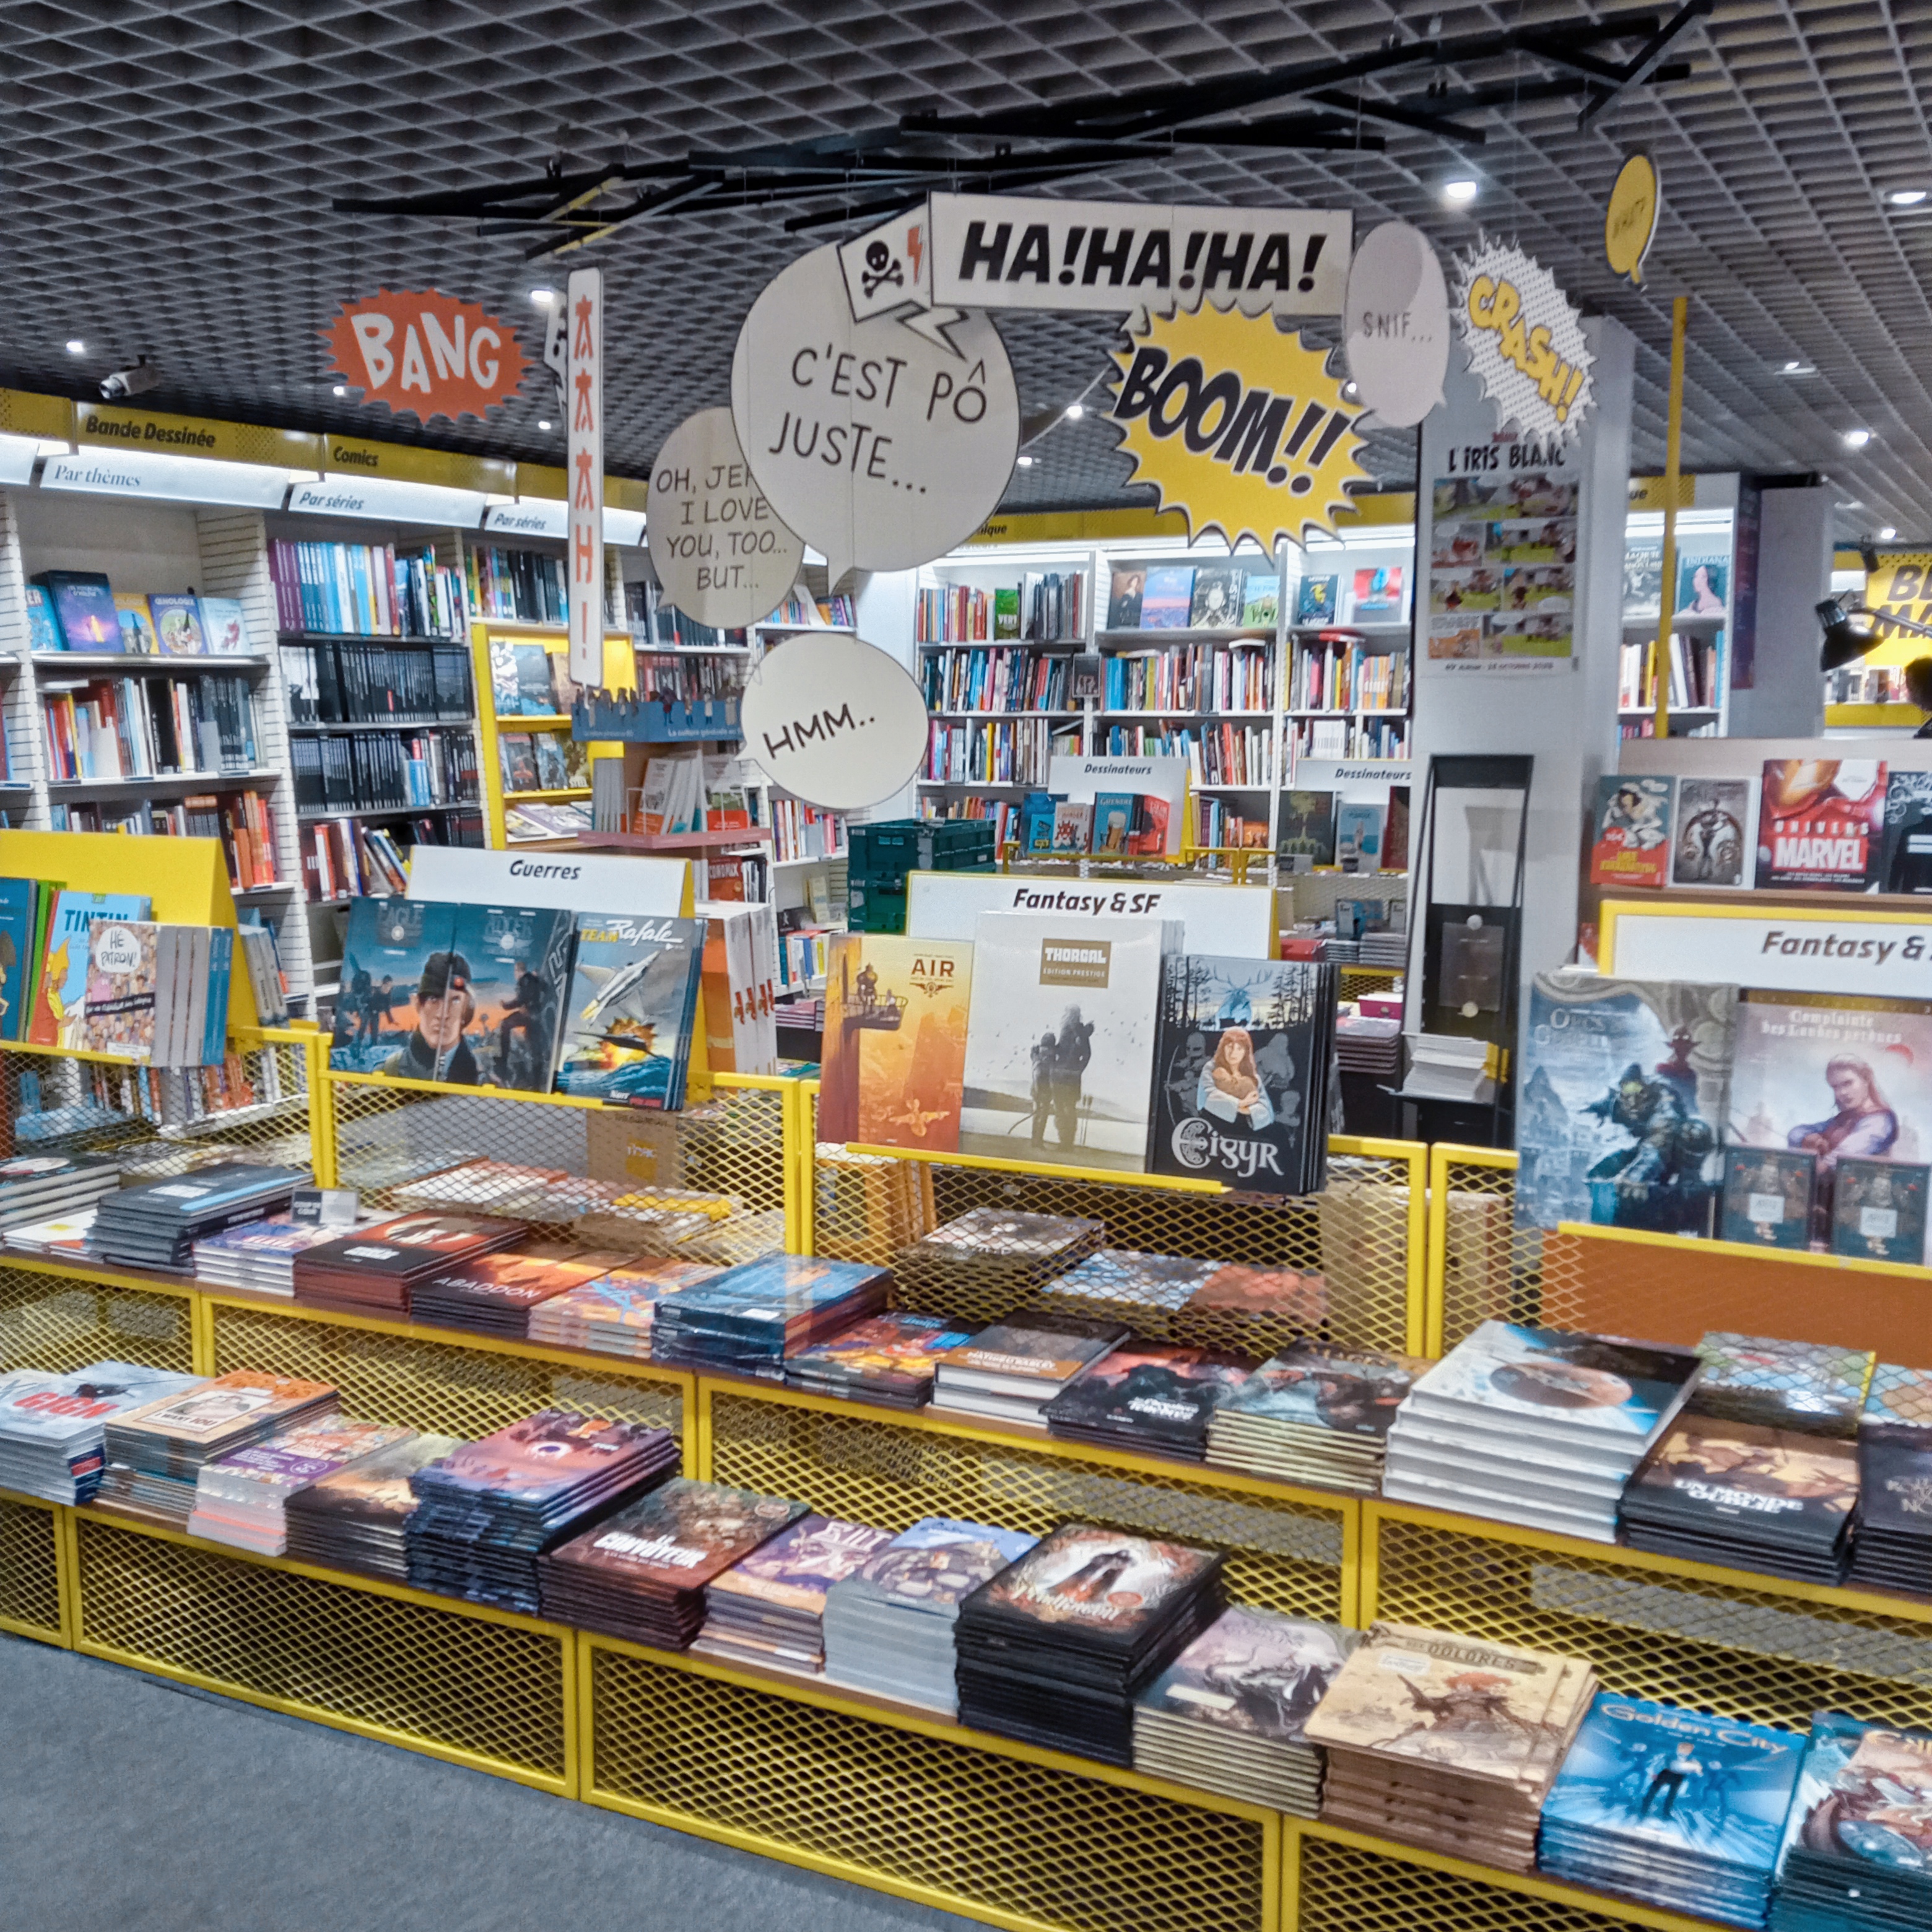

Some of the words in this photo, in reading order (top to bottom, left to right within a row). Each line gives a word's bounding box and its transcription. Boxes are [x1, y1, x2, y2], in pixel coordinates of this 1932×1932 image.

[1362, 313, 1433, 342] SNIF...
[351, 311, 501, 394] BANG
[791, 342, 908, 408] C'EST
[925, 358, 988, 424] PÔ
[85, 414, 141, 440] Bande
[144, 421, 215, 448] Dessinée
[1113, 347, 1354, 495] BOOM!!
[333, 445, 379, 468] Comics
[768, 412, 927, 494] JUSTE...
[53, 464, 82, 483] Par
[84, 466, 142, 488] thèmes
[656, 468, 697, 495] OH,
[299, 492, 323, 508] Par
[325, 494, 365, 511] séries
[682, 500, 695, 525] I
[704, 497, 769, 524] LOVE
[495, 512, 514, 527] Par
[516, 515, 546, 531] séries
[666, 533, 720, 560] YOU,
[697, 565, 759, 592] BUT...
[762, 702, 876, 759] HMM..
[1084, 762, 1152, 776] Dessinateurs
[1335, 767, 1412, 780] Dessinateurs
[1775, 837, 1865, 870] MARVEL
[509, 859, 581, 881] Guerres
[1012, 887, 1107, 916] Fantasy
[1110, 892, 1126, 912] &
[1129, 892, 1161, 913] SF
[580, 929, 619, 942] TEAM
[606, 920, 684, 946] Rafale
[1045, 947, 1107, 964] THORGAL
[1761, 931, 1897, 965] Fantasy
[1901, 936, 1925, 960] &
[911, 959, 955, 978] AIR
[434, 1276, 541, 1300] ABADDON
[13, 1392, 119, 1419] GIGN
[1601, 1704, 1711, 1737] Golden
[1717, 1730, 1789, 1754] City
